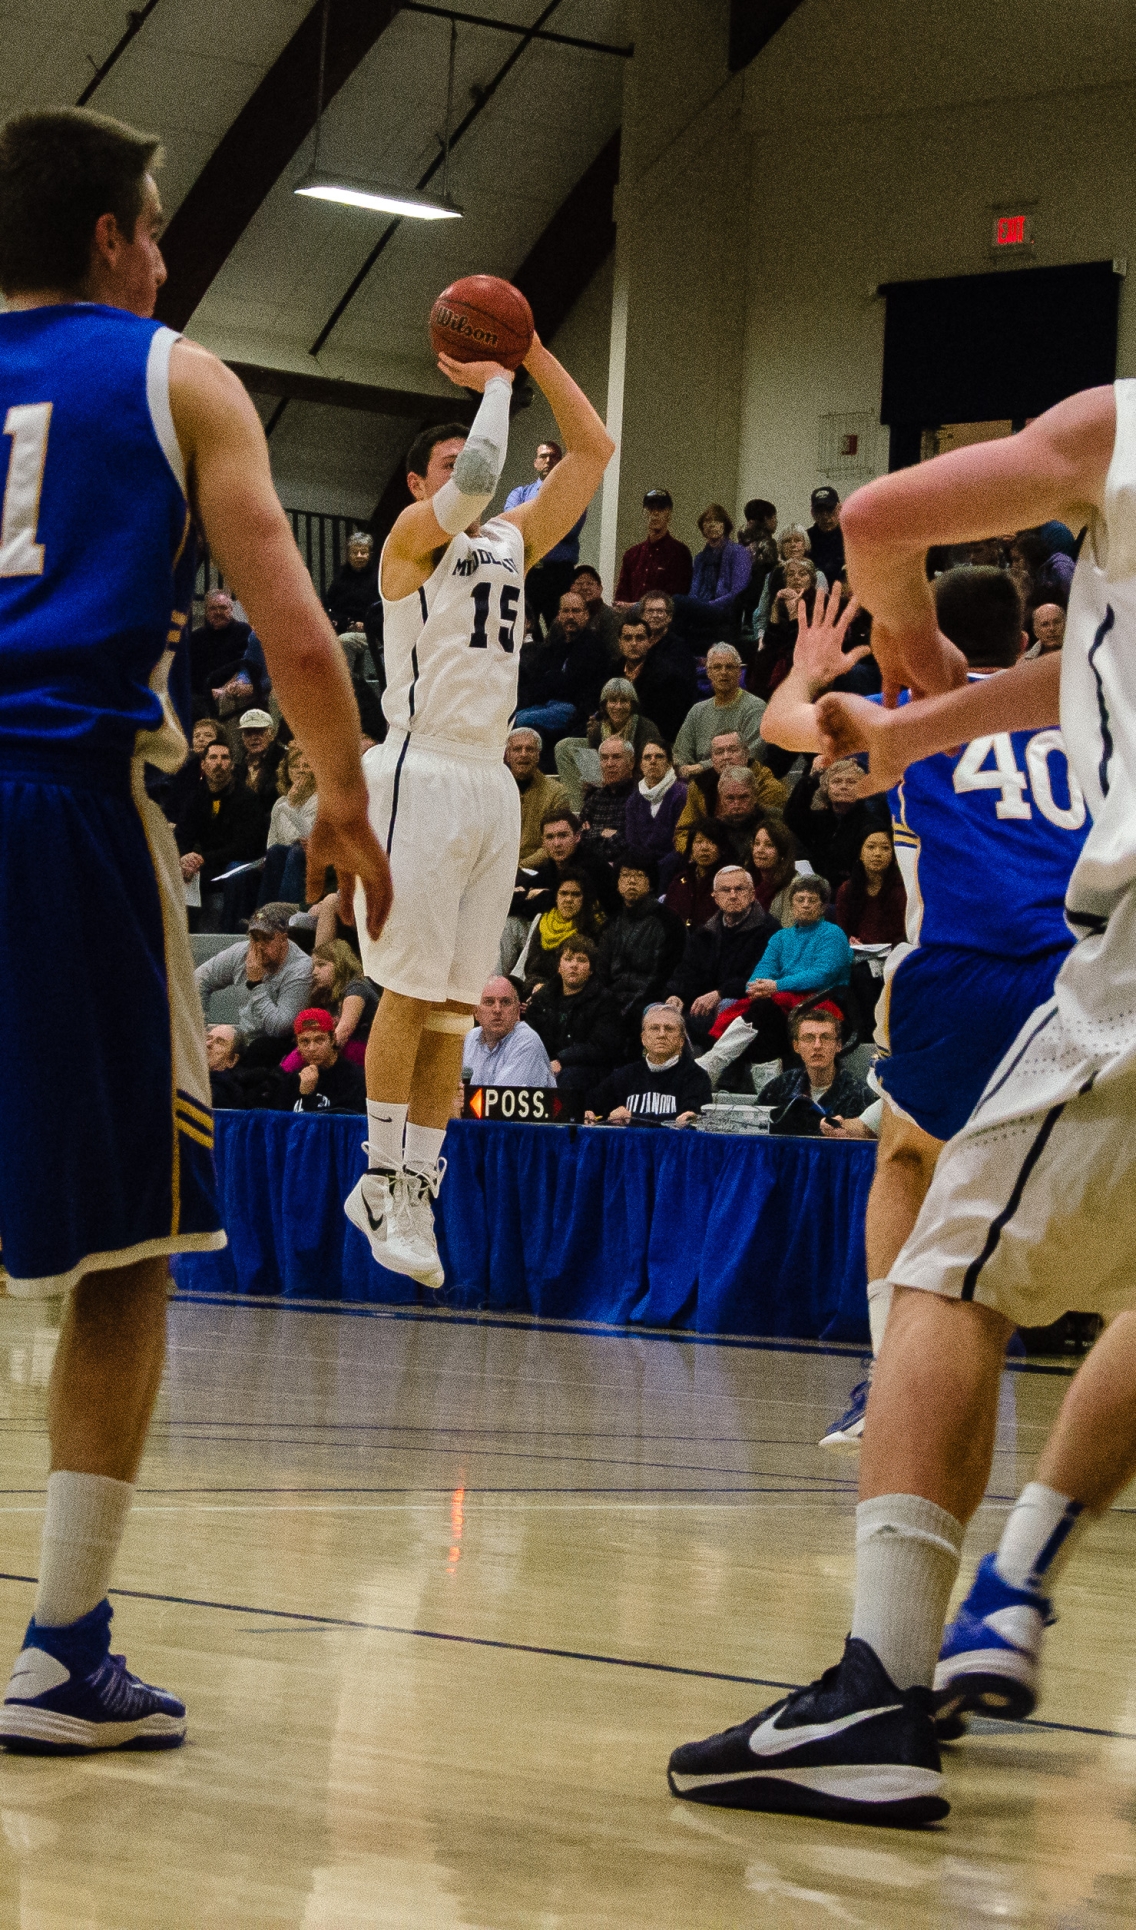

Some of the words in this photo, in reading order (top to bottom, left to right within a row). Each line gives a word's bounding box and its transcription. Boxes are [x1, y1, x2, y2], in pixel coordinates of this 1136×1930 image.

[998, 216, 1025, 244] EXIT
[436, 305, 498, 347] Wilson
[0, 402, 53, 577] 1
[469, 582, 520, 653] 15
[952, 730, 1087, 830] 40
[485, 1088, 547, 1118] POSS.
